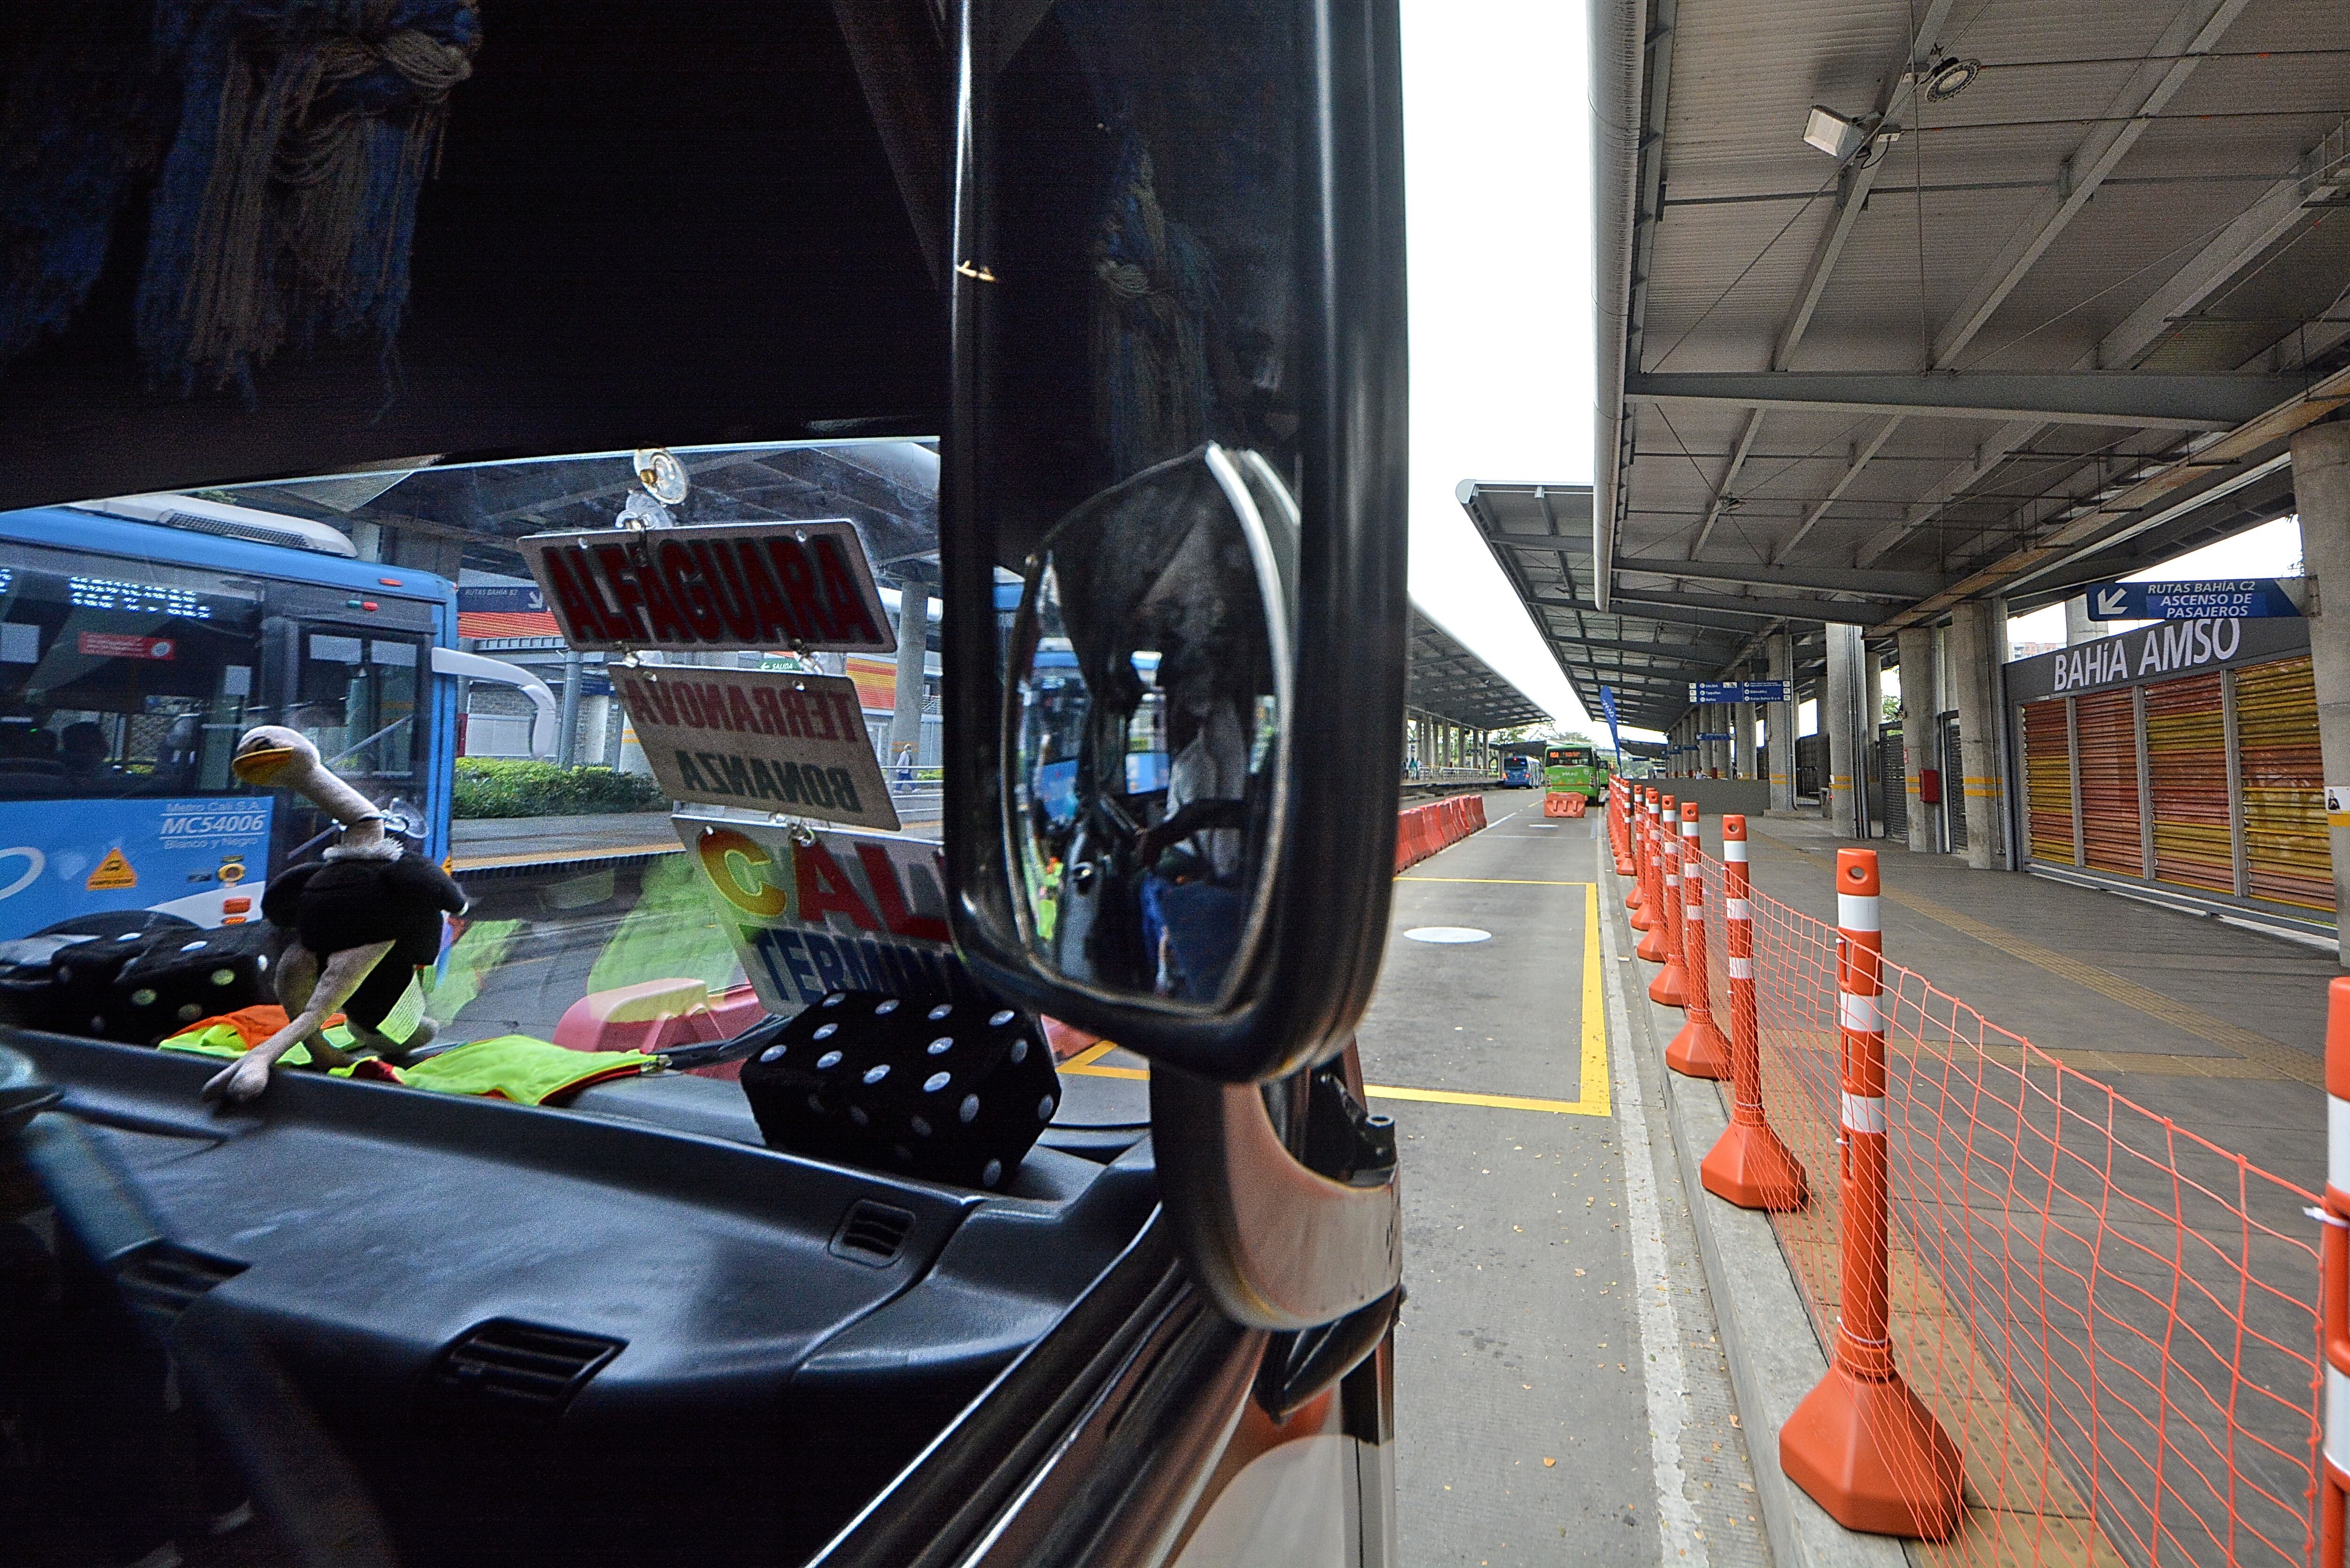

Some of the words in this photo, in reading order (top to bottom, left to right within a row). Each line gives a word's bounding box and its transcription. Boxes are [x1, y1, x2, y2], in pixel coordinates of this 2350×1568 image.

[541, 534, 884, 643] ALFAGUARA
[2148, 584, 2191, 594] RUTAS
[2194, 581, 2235, 593] BAHÍA
[2240, 581, 2256, 591] C2
[2161, 594, 2228, 606] ASCENSO
[2233, 593, 2253, 604] DE
[2166, 606, 2248, 618] PASAJEROS
[2138, 618, 2240, 676] AMSO
[160, 814, 266, 835] MC54006
[697, 829, 951, 941] CAL
